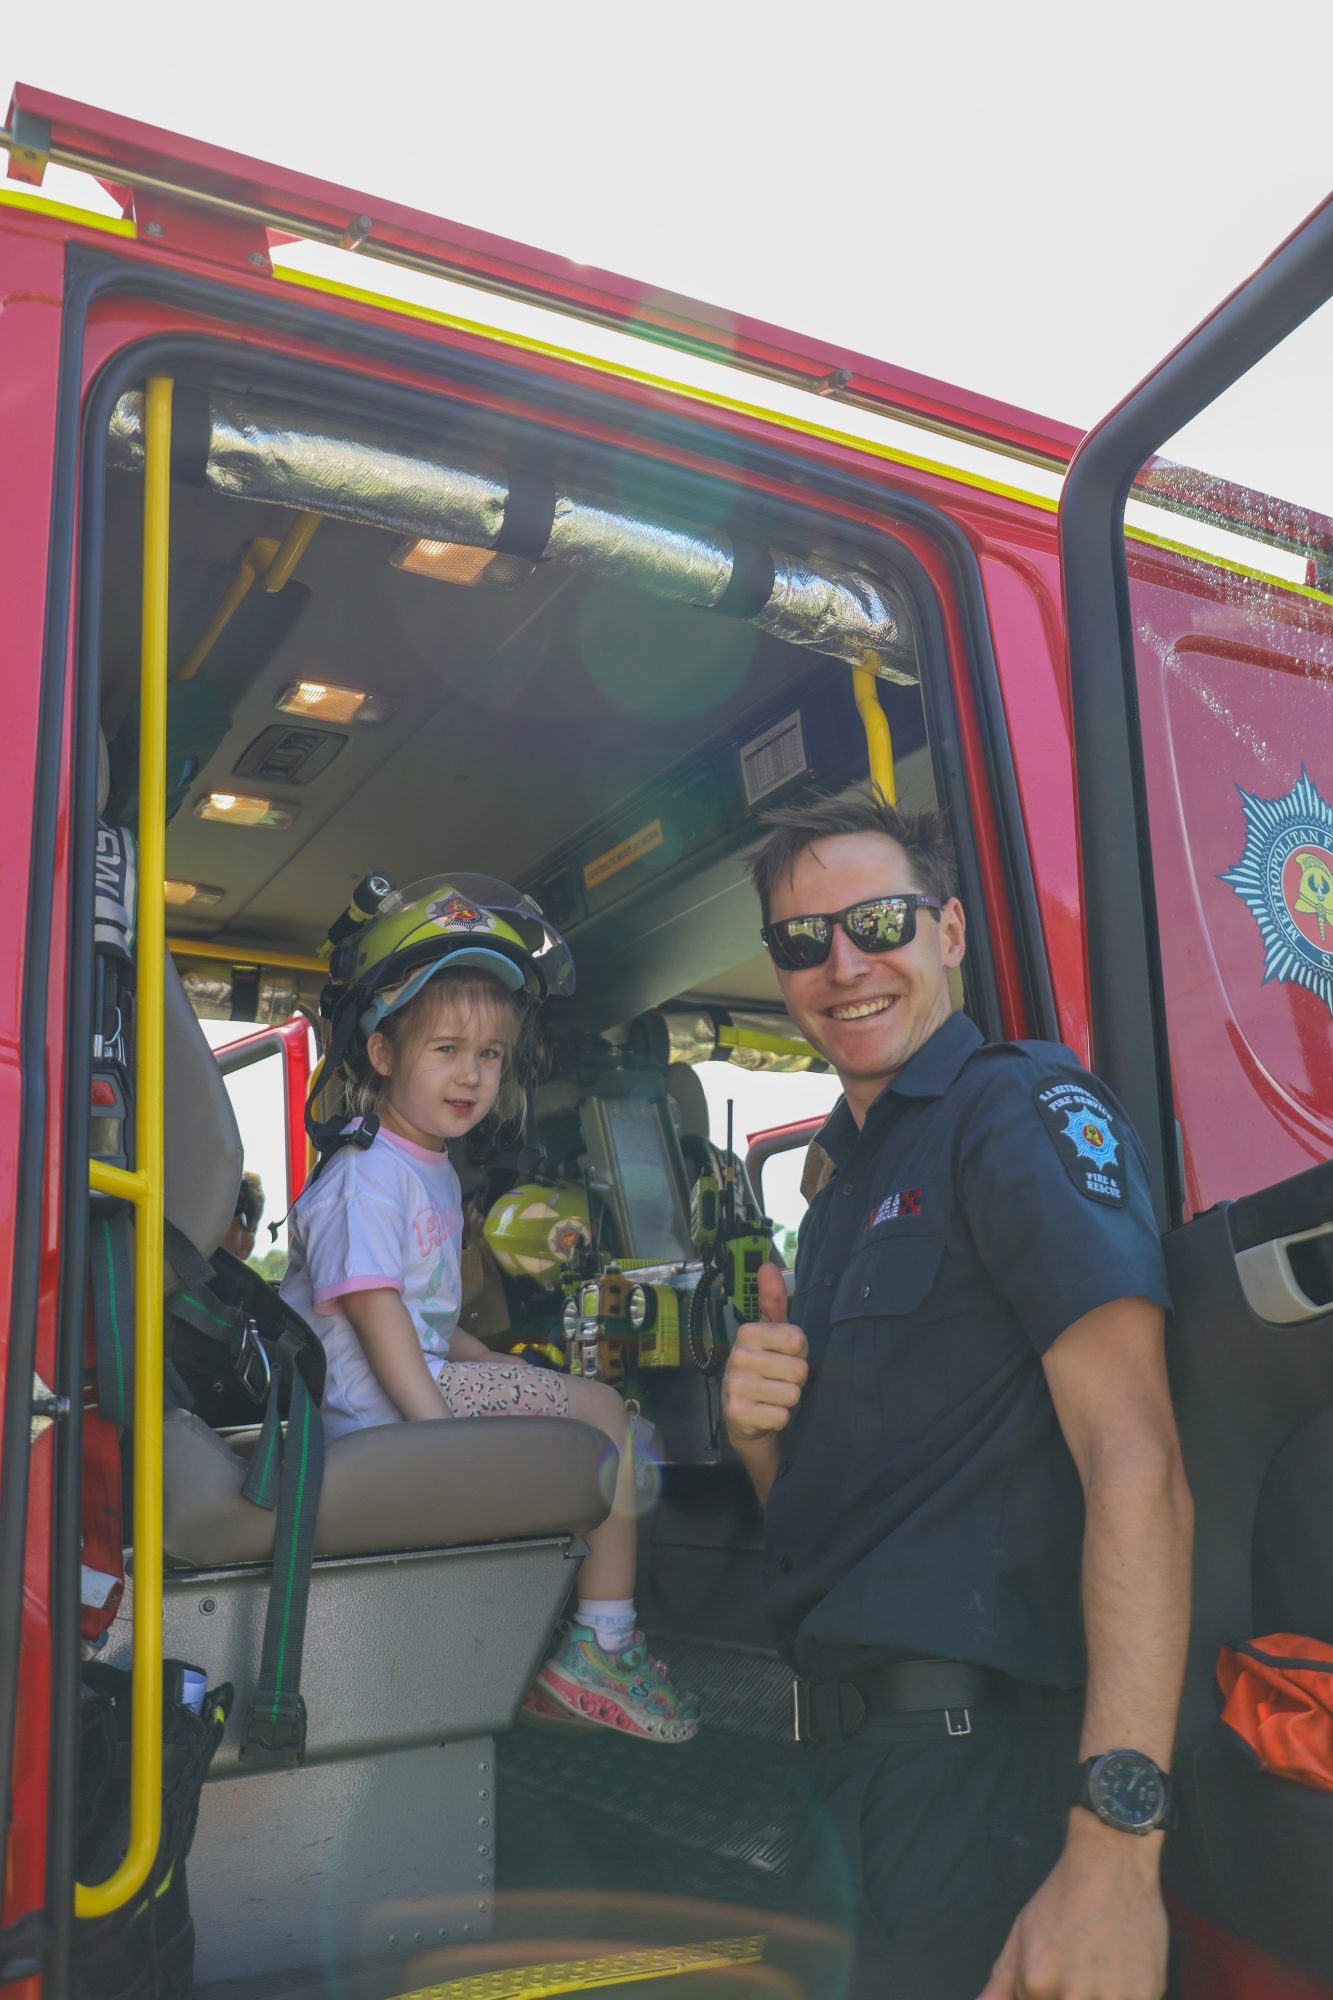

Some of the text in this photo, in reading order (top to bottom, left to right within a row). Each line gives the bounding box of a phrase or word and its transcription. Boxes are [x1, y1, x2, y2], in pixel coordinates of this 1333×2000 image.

[1269, 830, 1333, 942] METROPOLITAN F
[1048, 1095, 1113, 1122] FIRE SERVICE
[1086, 1171, 1108, 1184] FIRE
[1086, 1180, 1121, 1198] RESCUE
